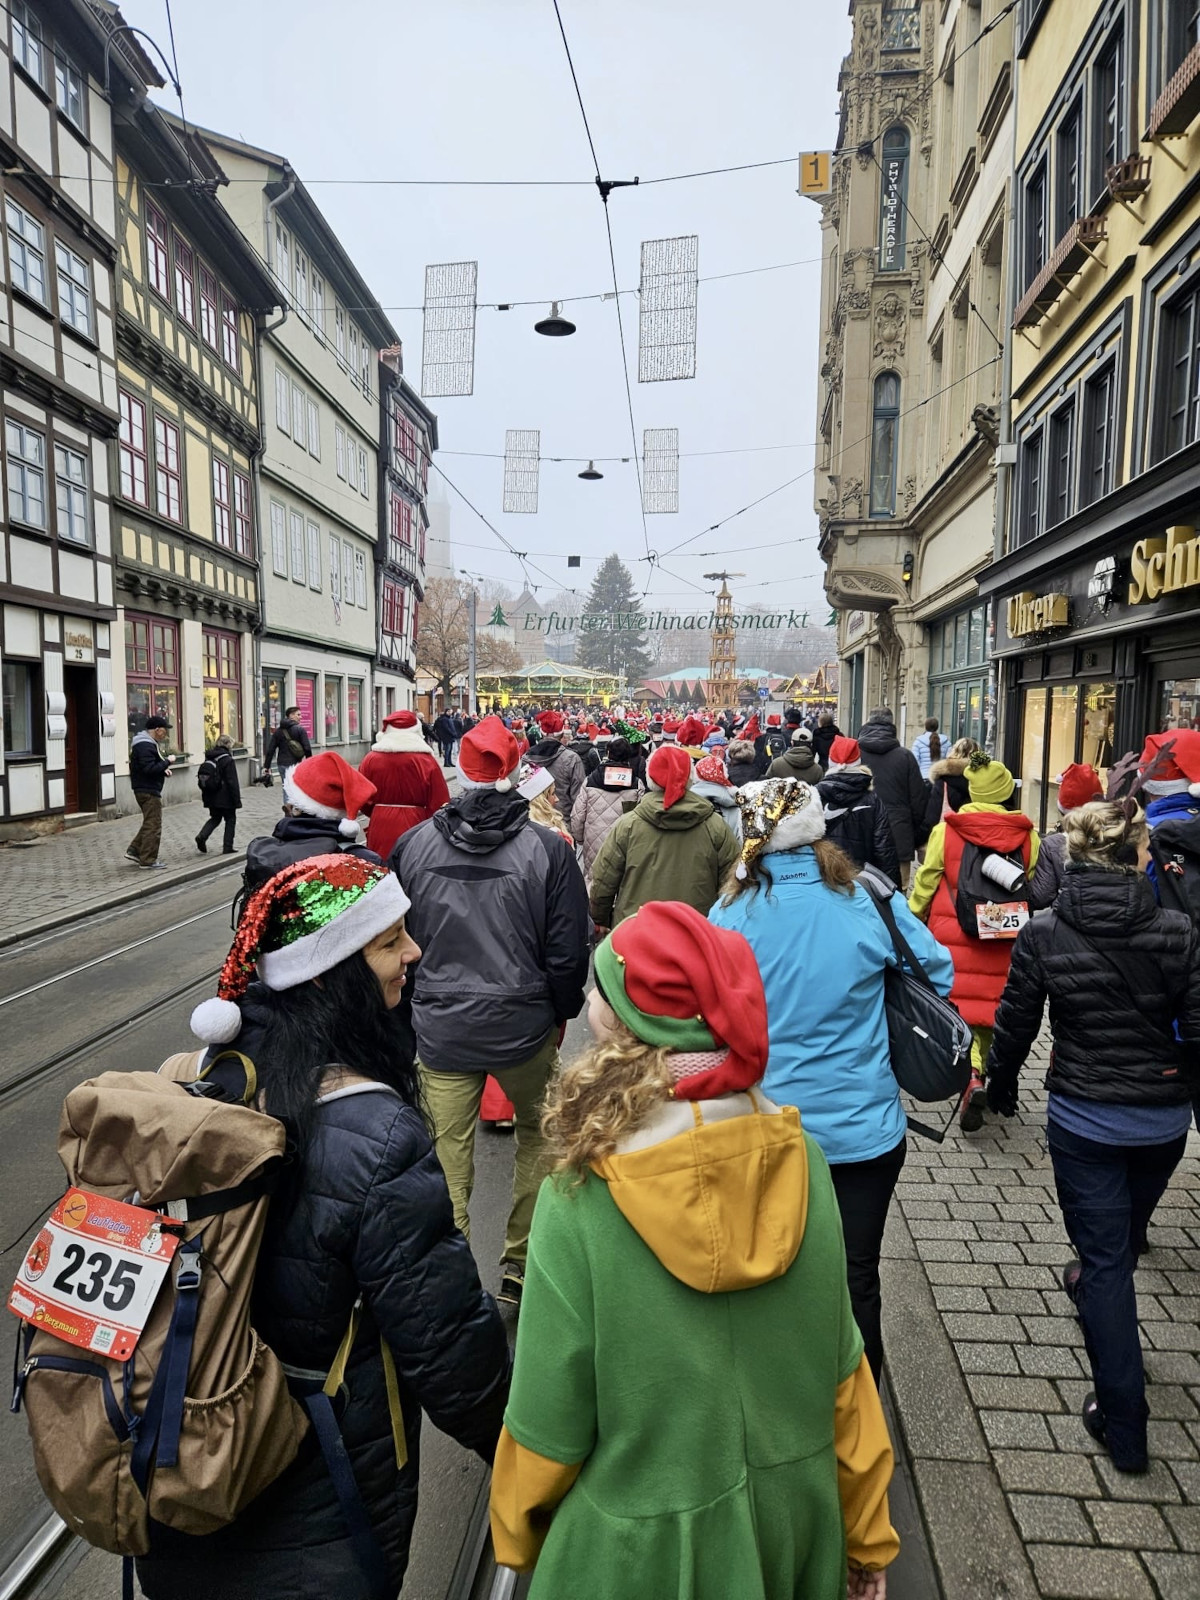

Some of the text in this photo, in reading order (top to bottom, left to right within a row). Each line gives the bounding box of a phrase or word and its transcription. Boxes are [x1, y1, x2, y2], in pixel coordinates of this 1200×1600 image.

[809, 157, 820, 181] 1
[886, 161, 899, 263] PHYSIOTHERAPIE
[522, 608, 809, 636] Erfurter Weihnachtsmarkt
[1006, 592, 1068, 639] Uhren
[617, 773, 627, 781] 72
[53, 1243, 143, 1311] 235
[44, 1313, 79, 1336] Bergmann
